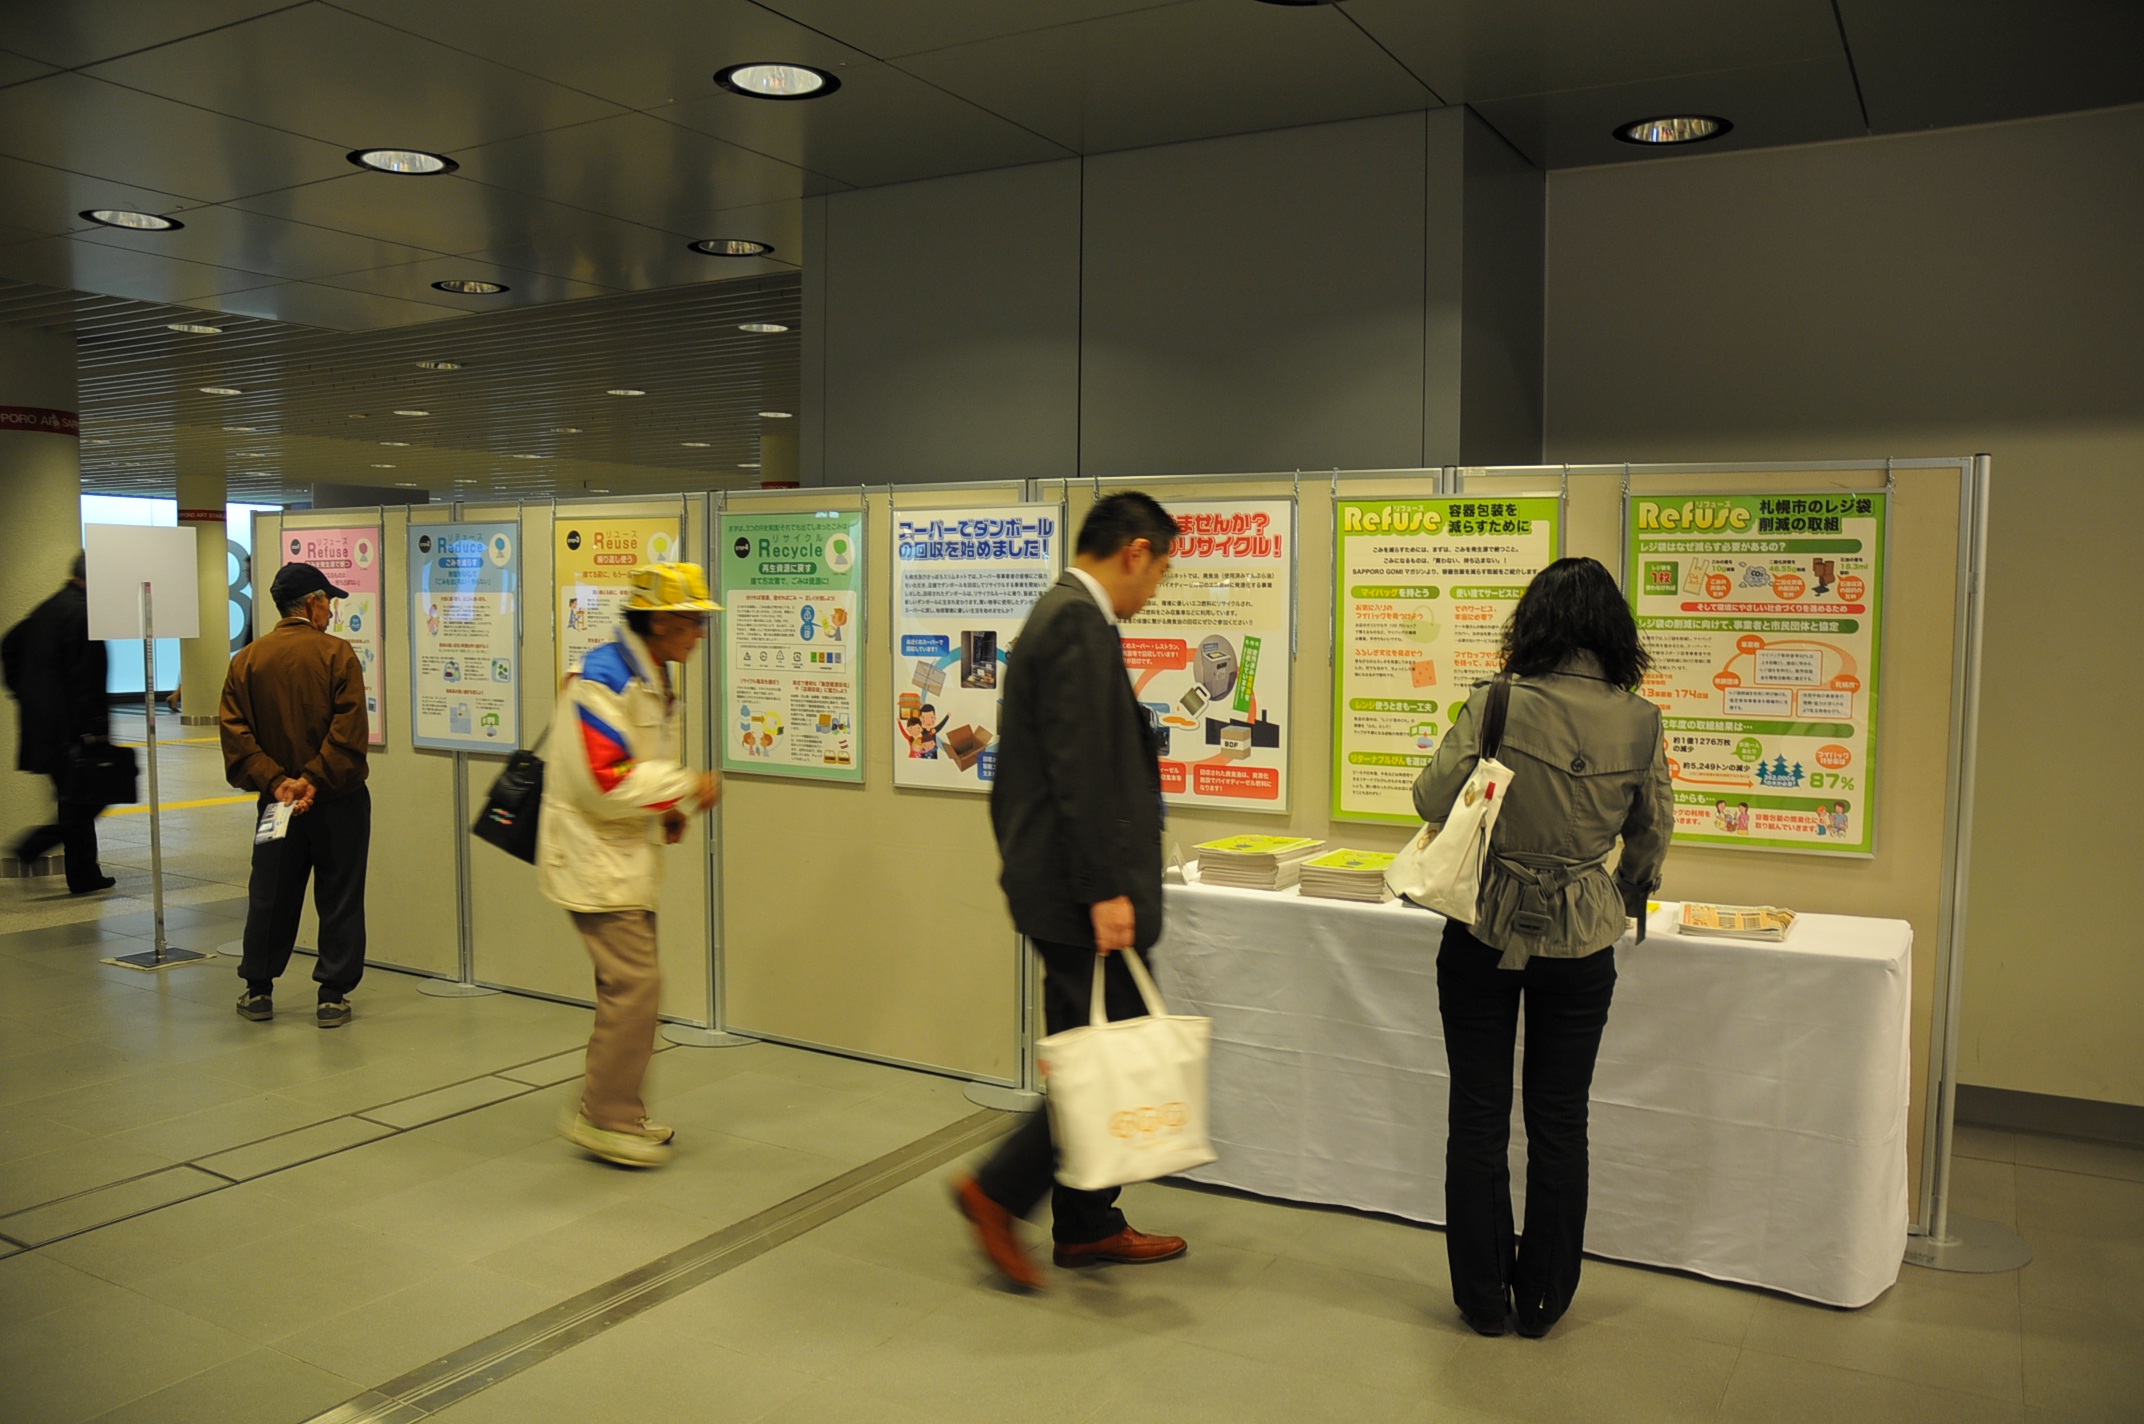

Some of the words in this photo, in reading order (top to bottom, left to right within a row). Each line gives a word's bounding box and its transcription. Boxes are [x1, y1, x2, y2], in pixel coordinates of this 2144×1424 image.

[1449, 504, 1518, 518] 容器包装を
[1759, 498, 1872, 515] 札幌市のレジ袋
[1170, 513, 1270, 534] ませんか？
[1344, 506, 1441, 532] Refuse
[1638, 501, 1751, 530] Refuse
[1758, 516, 1840, 532] 削減の取組
[606, 530, 637, 539] リユース
[899, 518, 1053, 539] スーパーでダンボール
[1448, 519, 1530, 534] 減らすために
[438, 537, 483, 554] Reduce
[594, 532, 638, 550] Reuse
[773, 535, 823, 543] リサイクル
[307, 542, 348, 559] Refuse
[758, 538, 823, 560] Recycle
[899, 539, 1050, 558] の回収を始めました！
[1809, 771, 1855, 790] 87%
